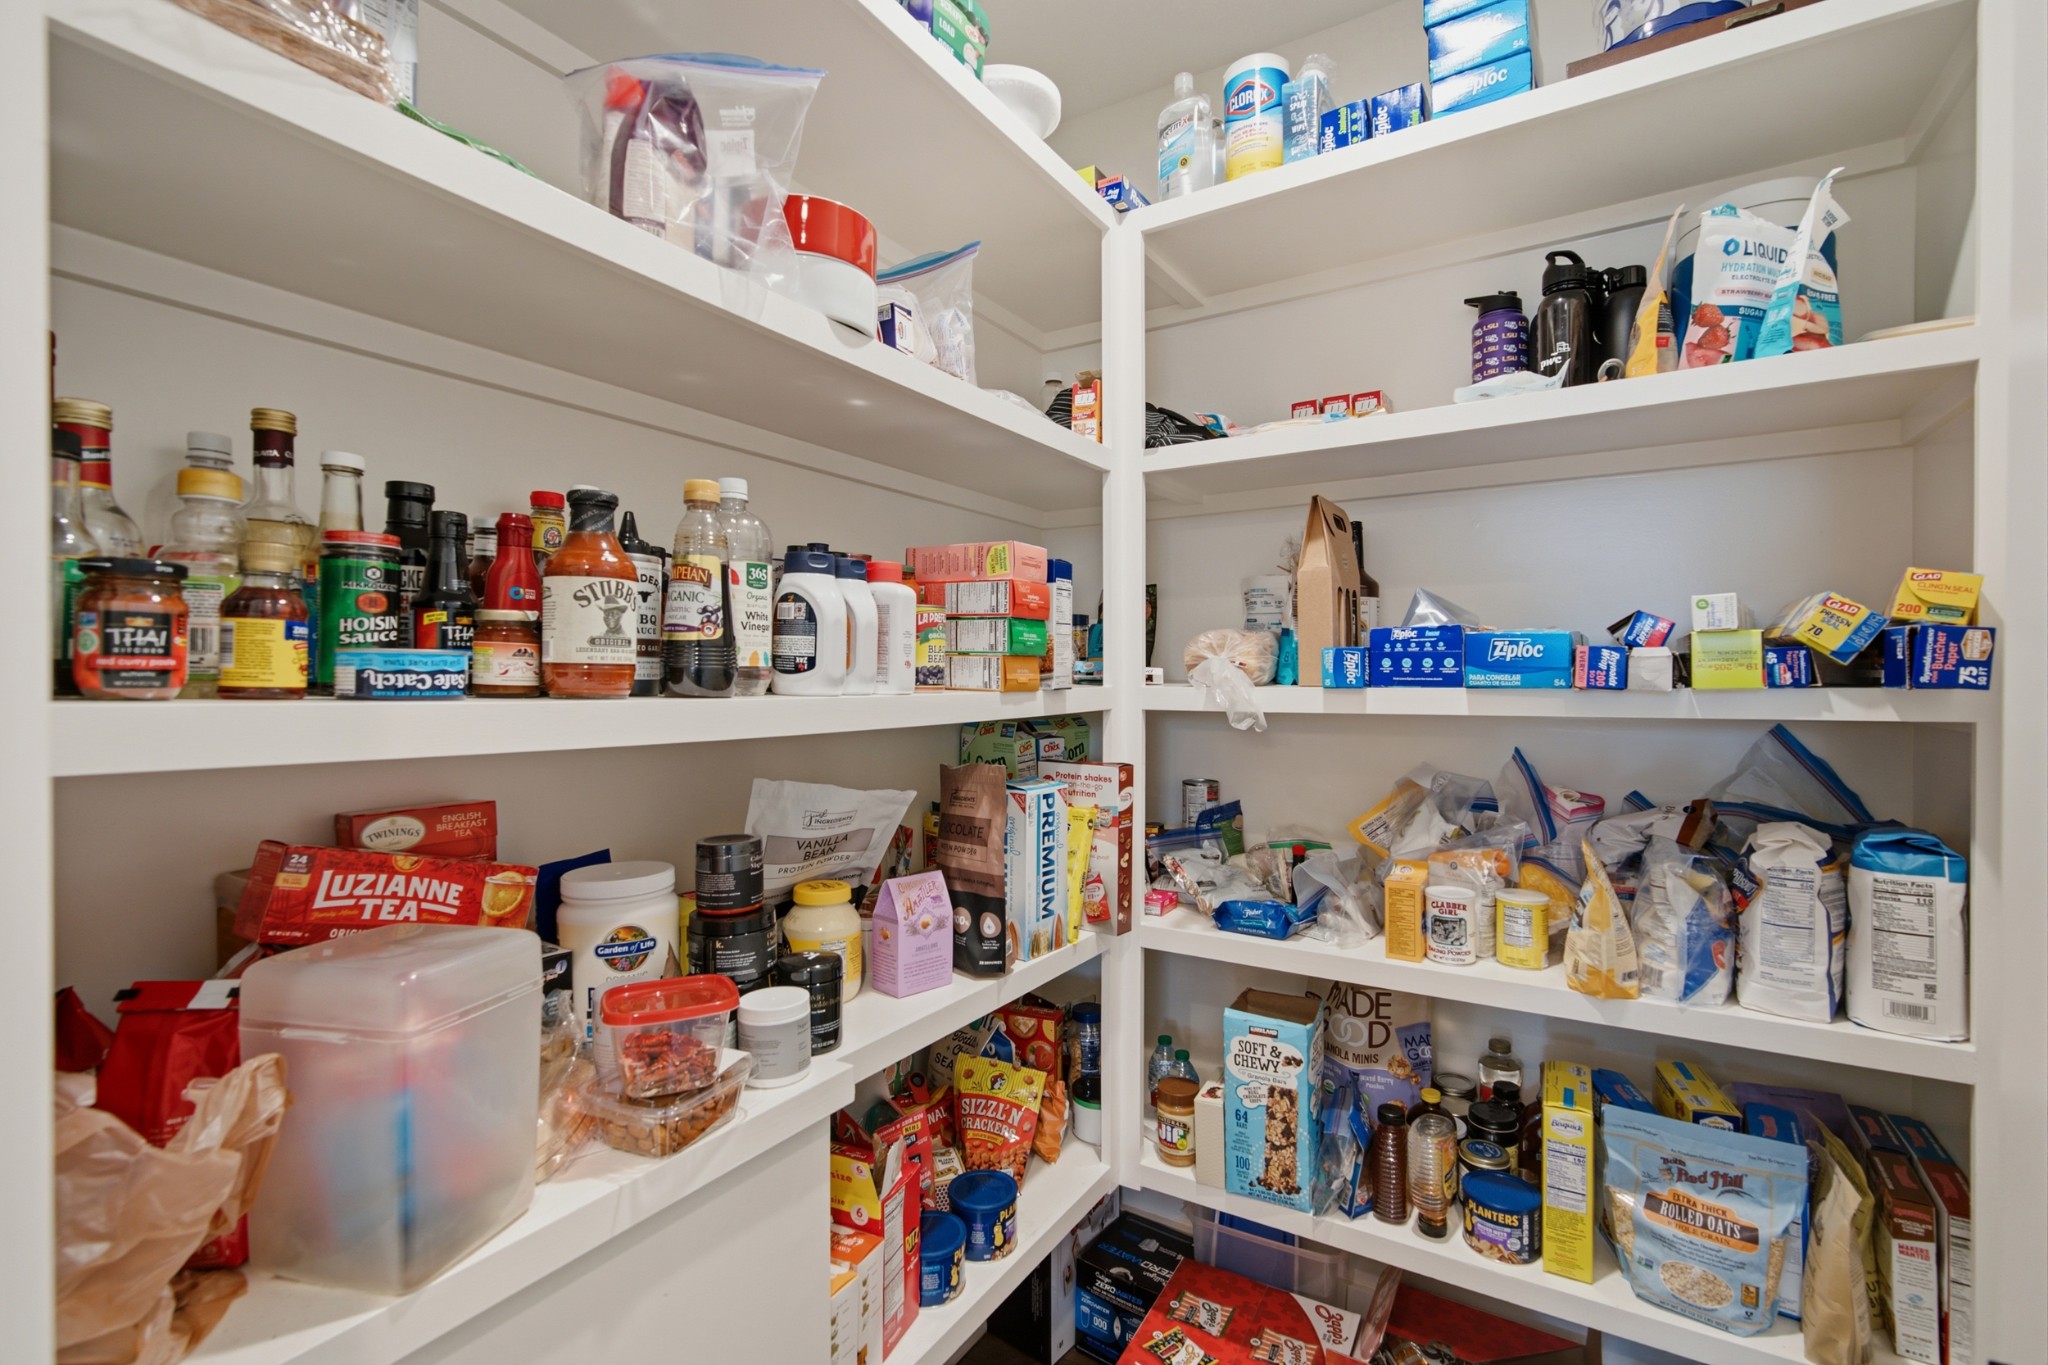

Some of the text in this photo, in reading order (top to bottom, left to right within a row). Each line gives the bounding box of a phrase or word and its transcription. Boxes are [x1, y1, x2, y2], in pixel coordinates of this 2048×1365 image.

[1743, 240, 1788, 264] LIQUID
[1720, 262, 1766, 274] HYDRATION
[1738, 307, 1763, 316] SUGAR
[748, 567, 767, 580] 365
[1826, 598, 1858, 616] GLAD
[1896, 603, 1921, 614] 200
[640, 614, 657, 625] BQ
[745, 611, 768, 621] White
[917, 614, 928, 624] LA
[339, 616, 398, 632] HOISIN
[1807, 624, 1823, 637] 70
[104, 627, 168, 647] THAI
[339, 630, 398, 645] sauce
[1391, 629, 1418, 640] Ziploc
[1493, 640, 1544, 662] Ziploc
[1766, 651, 1778, 664] 45
[1931, 631, 1948, 670] Butcher
[1944, 641, 1960, 671] Paper
[1344, 651, 1357, 685] Ziploc
[1608, 651, 1620, 687] Reynolds
[1958, 666, 1978, 685] 75
[363, 670, 432, 690] Catch
[1596, 670, 1606, 687] 200
[979, 725, 996, 736] Chex
[1019, 743, 1033, 753] Chex
[1043, 743, 1060, 753] Chex
[1055, 771, 1113, 783] Protein shakes
[1068, 789, 1097, 798] utrition
[442, 811, 482, 822] ENGLISH
[436, 818, 488, 832] BREAKFAST
[949, 819, 984, 840] COLATE
[366, 827, 421, 843] TWININGS
[454, 829, 473, 838] TEA
[797, 834, 849, 851] VANILLA
[290, 854, 308, 864] 24
[803, 845, 837, 861] BEAN
[1041, 792, 1056, 920] PREMIUM
[777, 862, 813, 874] PROTEIN
[312, 869, 464, 909] LUZIANNE
[1873, 877, 1933, 889] Nutrition Facts
[358, 898, 418, 922] TEA
[1431, 900, 1468, 911] CLABBER
[1438, 908, 1459, 916] GIRL
[597, 939, 655, 956] Garden of Life
[1326, 981, 1392, 1020] MADE
[1238, 1040, 1282, 1059] SOFT &
[1407, 1046, 1432, 1061] GOO
[934, 1052, 954, 1071] SEA
[1233, 1053, 1280, 1074] CHEWY
[1352, 1052, 1379, 1064] MINIS
[927, 1106, 948, 1126] NAL
[1235, 1109, 1248, 1123] 64
[961, 1117, 1017, 1138] CRACKERS
[856, 1165, 863, 1174] 6
[1235, 1155, 1251, 1170] 100
[1676, 1166, 1744, 1190] Red Mill
[1672, 1192, 1728, 1217] EXTRA THICK
[856, 1207, 863, 1218] 6
[1468, 1199, 1519, 1227] PLANTERS
[1660, 1201, 1741, 1240] ROLLED OATS
[1700, 1231, 1731, 1246] GRAIN
